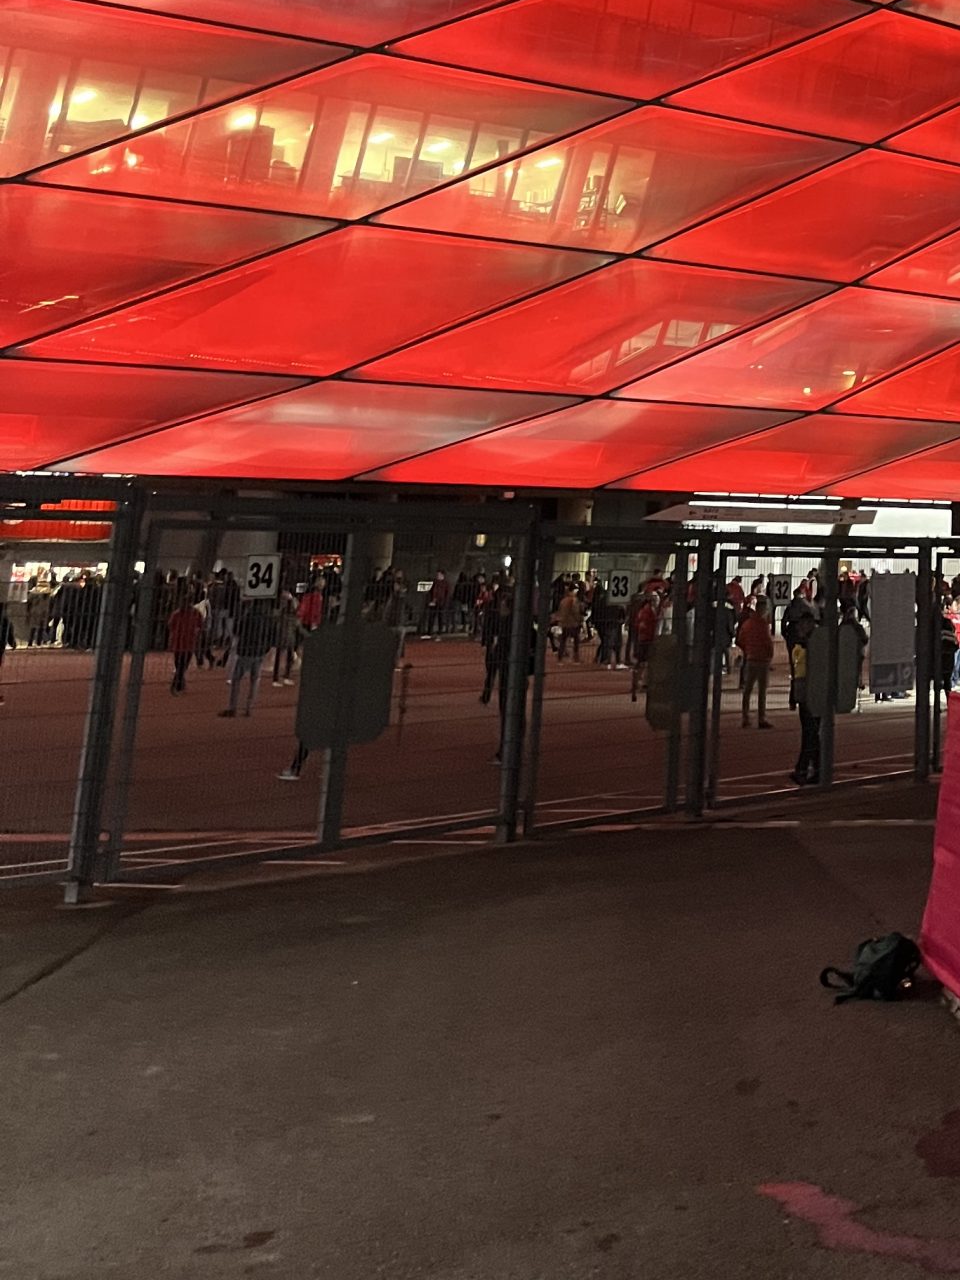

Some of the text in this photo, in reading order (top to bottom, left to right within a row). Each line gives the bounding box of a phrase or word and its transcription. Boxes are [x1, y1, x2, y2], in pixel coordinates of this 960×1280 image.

[248, 562, 274, 589] 34
[612, 576, 629, 597] 33
[775, 581, 789, 600] 32
